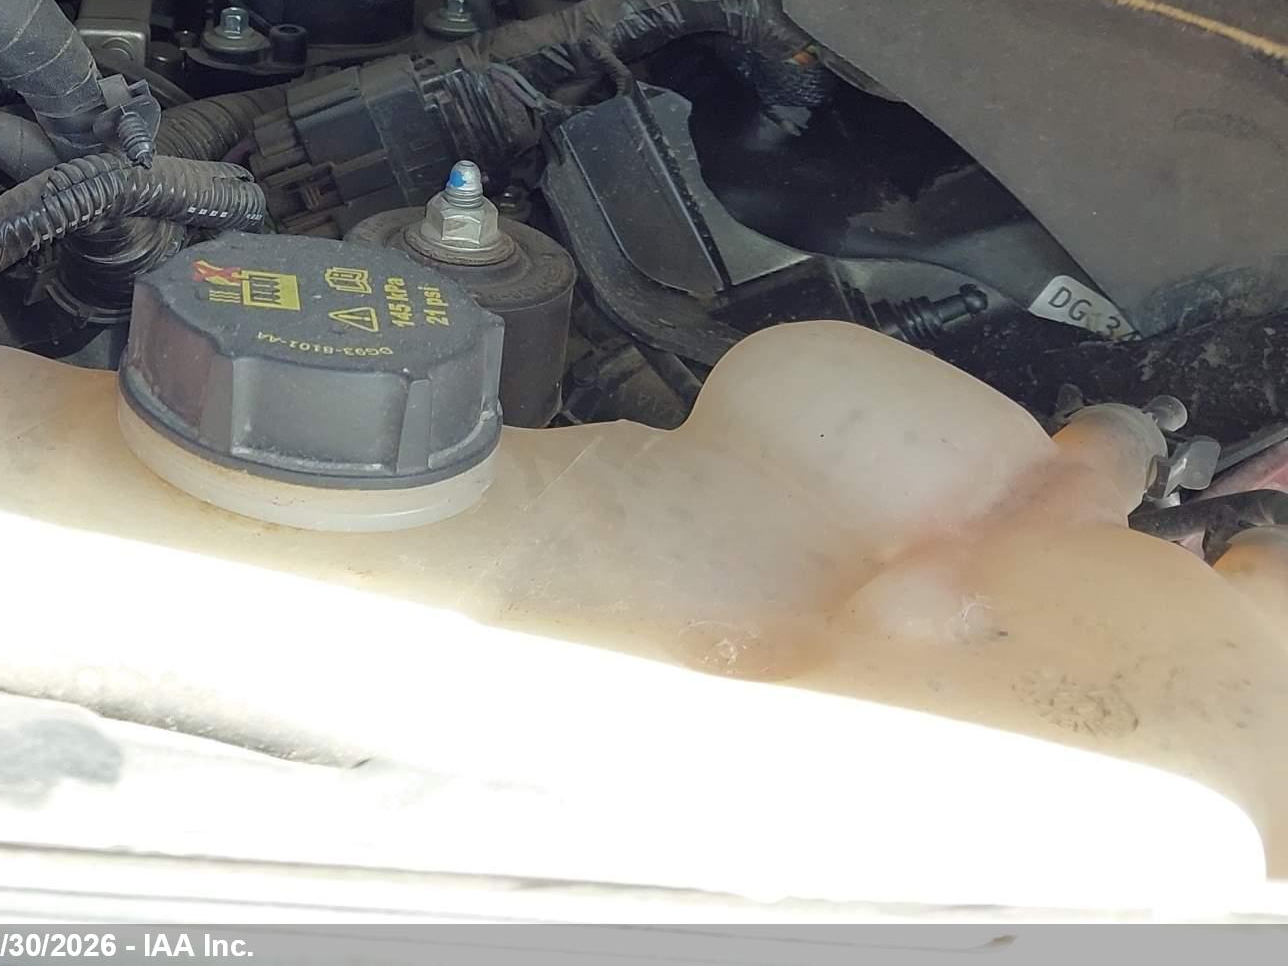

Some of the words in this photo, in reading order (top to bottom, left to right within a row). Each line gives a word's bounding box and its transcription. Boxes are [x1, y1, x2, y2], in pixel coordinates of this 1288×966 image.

[384, 277, 410, 301] kPa
[417, 283, 450, 307] psi
[388, 303, 416, 328] 145
[423, 309, 450, 327] 21
[257, 331, 394, 356] DG93-8101-AA
